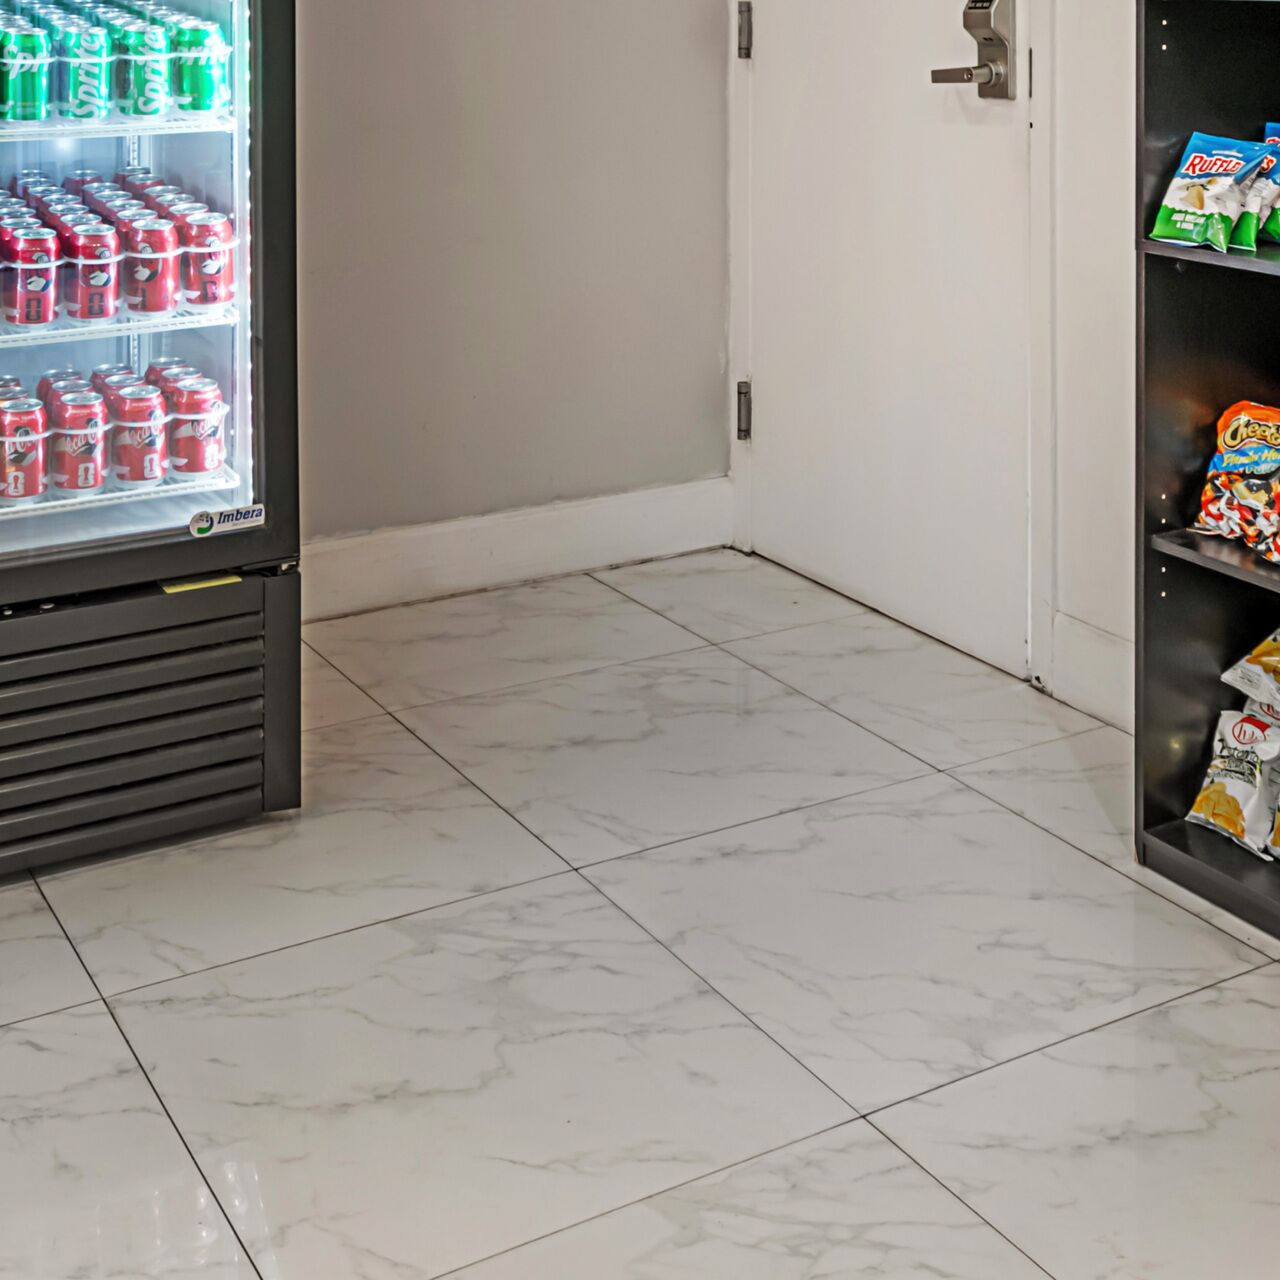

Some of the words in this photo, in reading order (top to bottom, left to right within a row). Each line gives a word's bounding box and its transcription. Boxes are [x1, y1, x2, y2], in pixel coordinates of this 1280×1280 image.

[71, 33, 100, 118] Sprite
[138, 30, 166, 113] Sprite
[217, 507, 263, 525] Imbera
